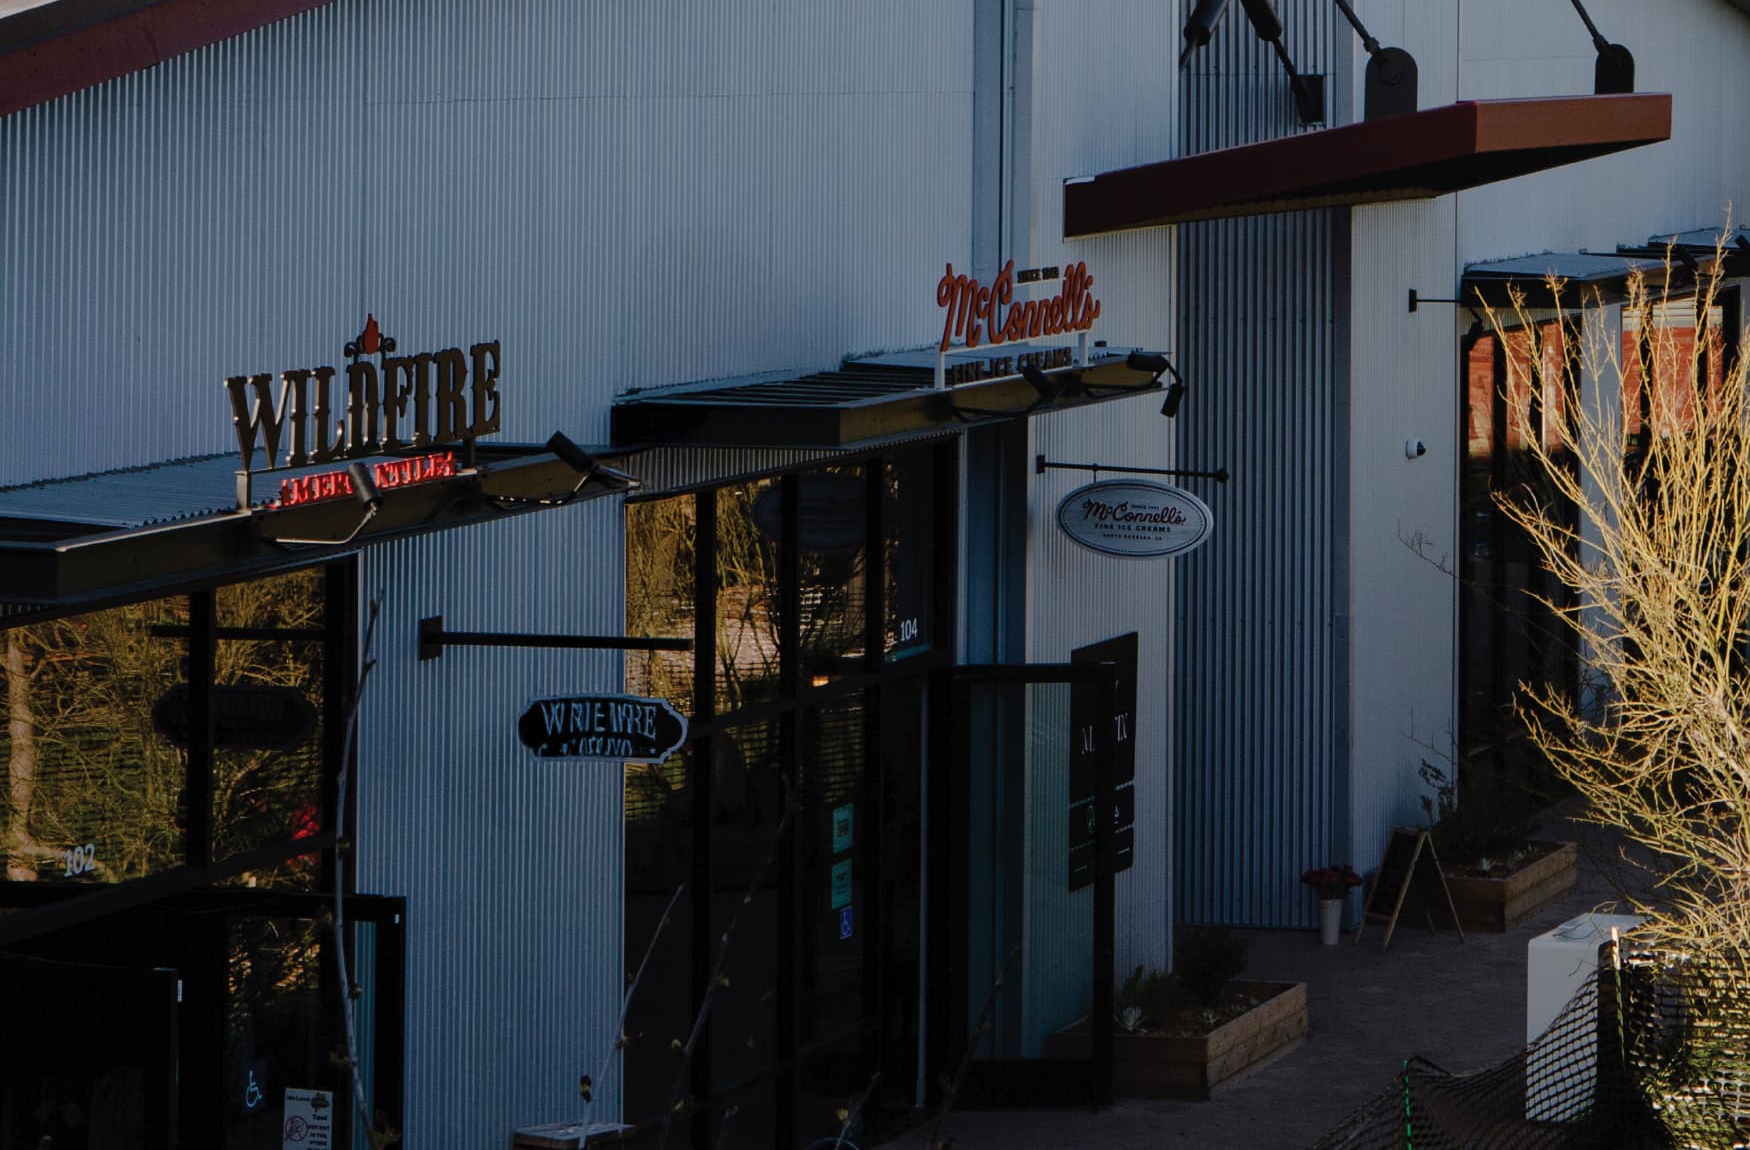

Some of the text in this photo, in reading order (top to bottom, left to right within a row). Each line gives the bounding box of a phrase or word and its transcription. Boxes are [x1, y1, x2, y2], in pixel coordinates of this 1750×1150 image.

[989, 356, 1013, 378] ICE
[224, 340, 501, 472] WILDFIRE
[1135, 525, 1171, 533] CREAMS
[900, 617, 918, 642] 104
[64, 843, 96, 878] 102
